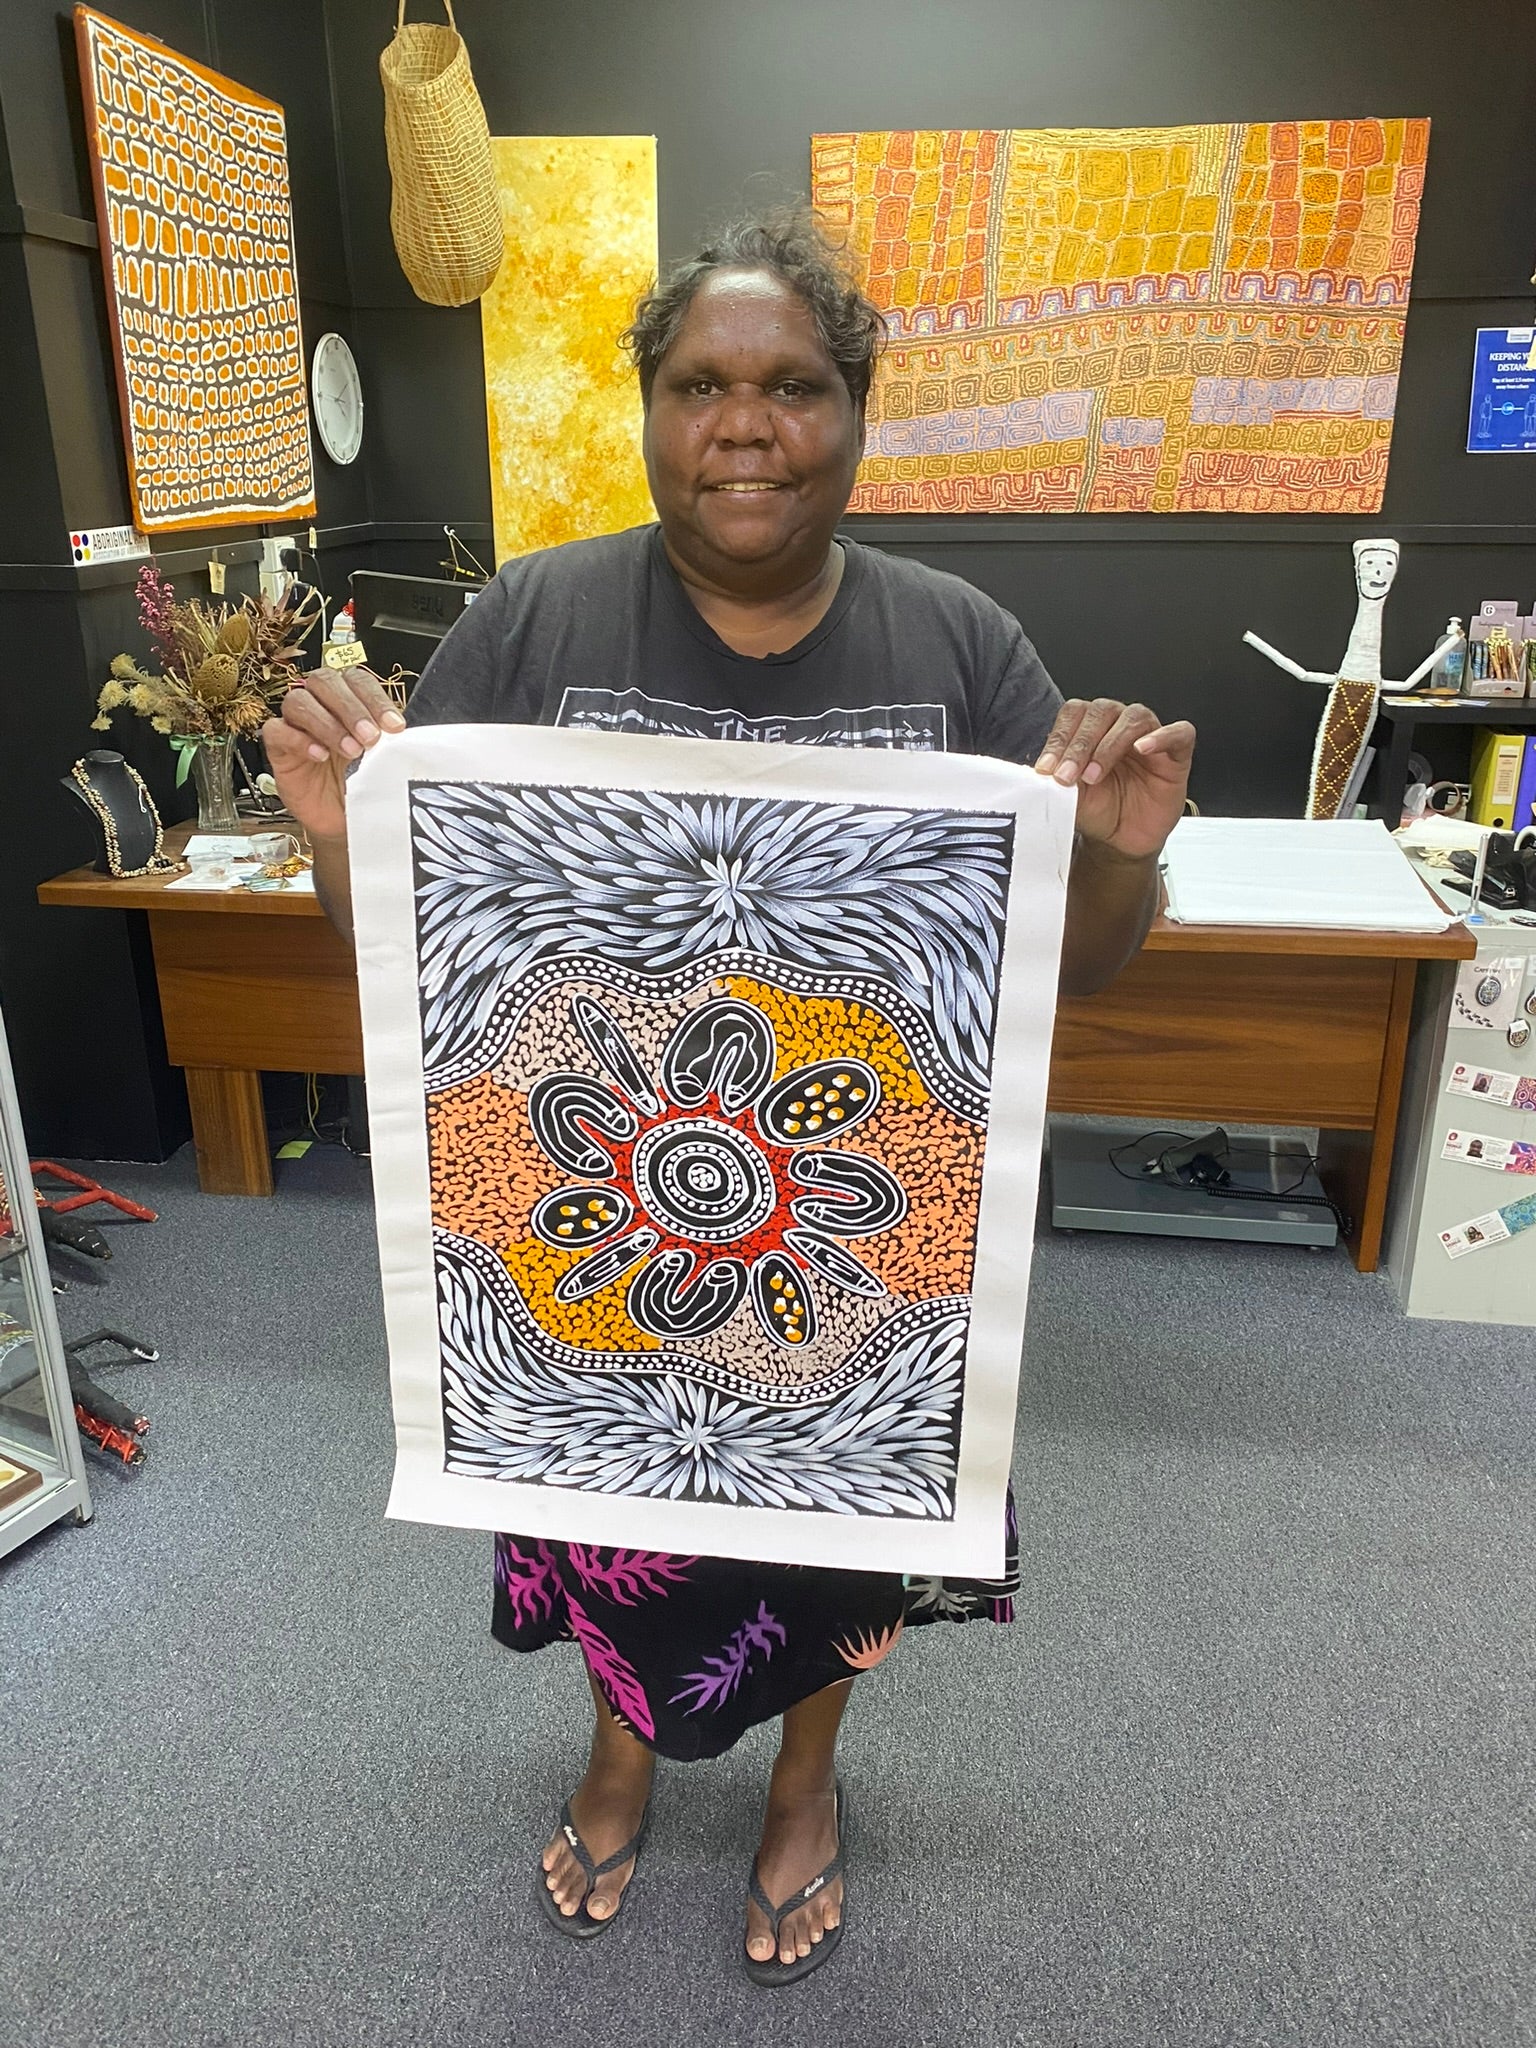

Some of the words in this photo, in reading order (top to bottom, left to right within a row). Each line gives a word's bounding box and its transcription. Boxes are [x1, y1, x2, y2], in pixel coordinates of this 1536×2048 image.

[1489, 352, 1522, 361] KEEPING
[93, 530, 132, 551] ABORIGINAL
[714, 718, 786, 750] THE
